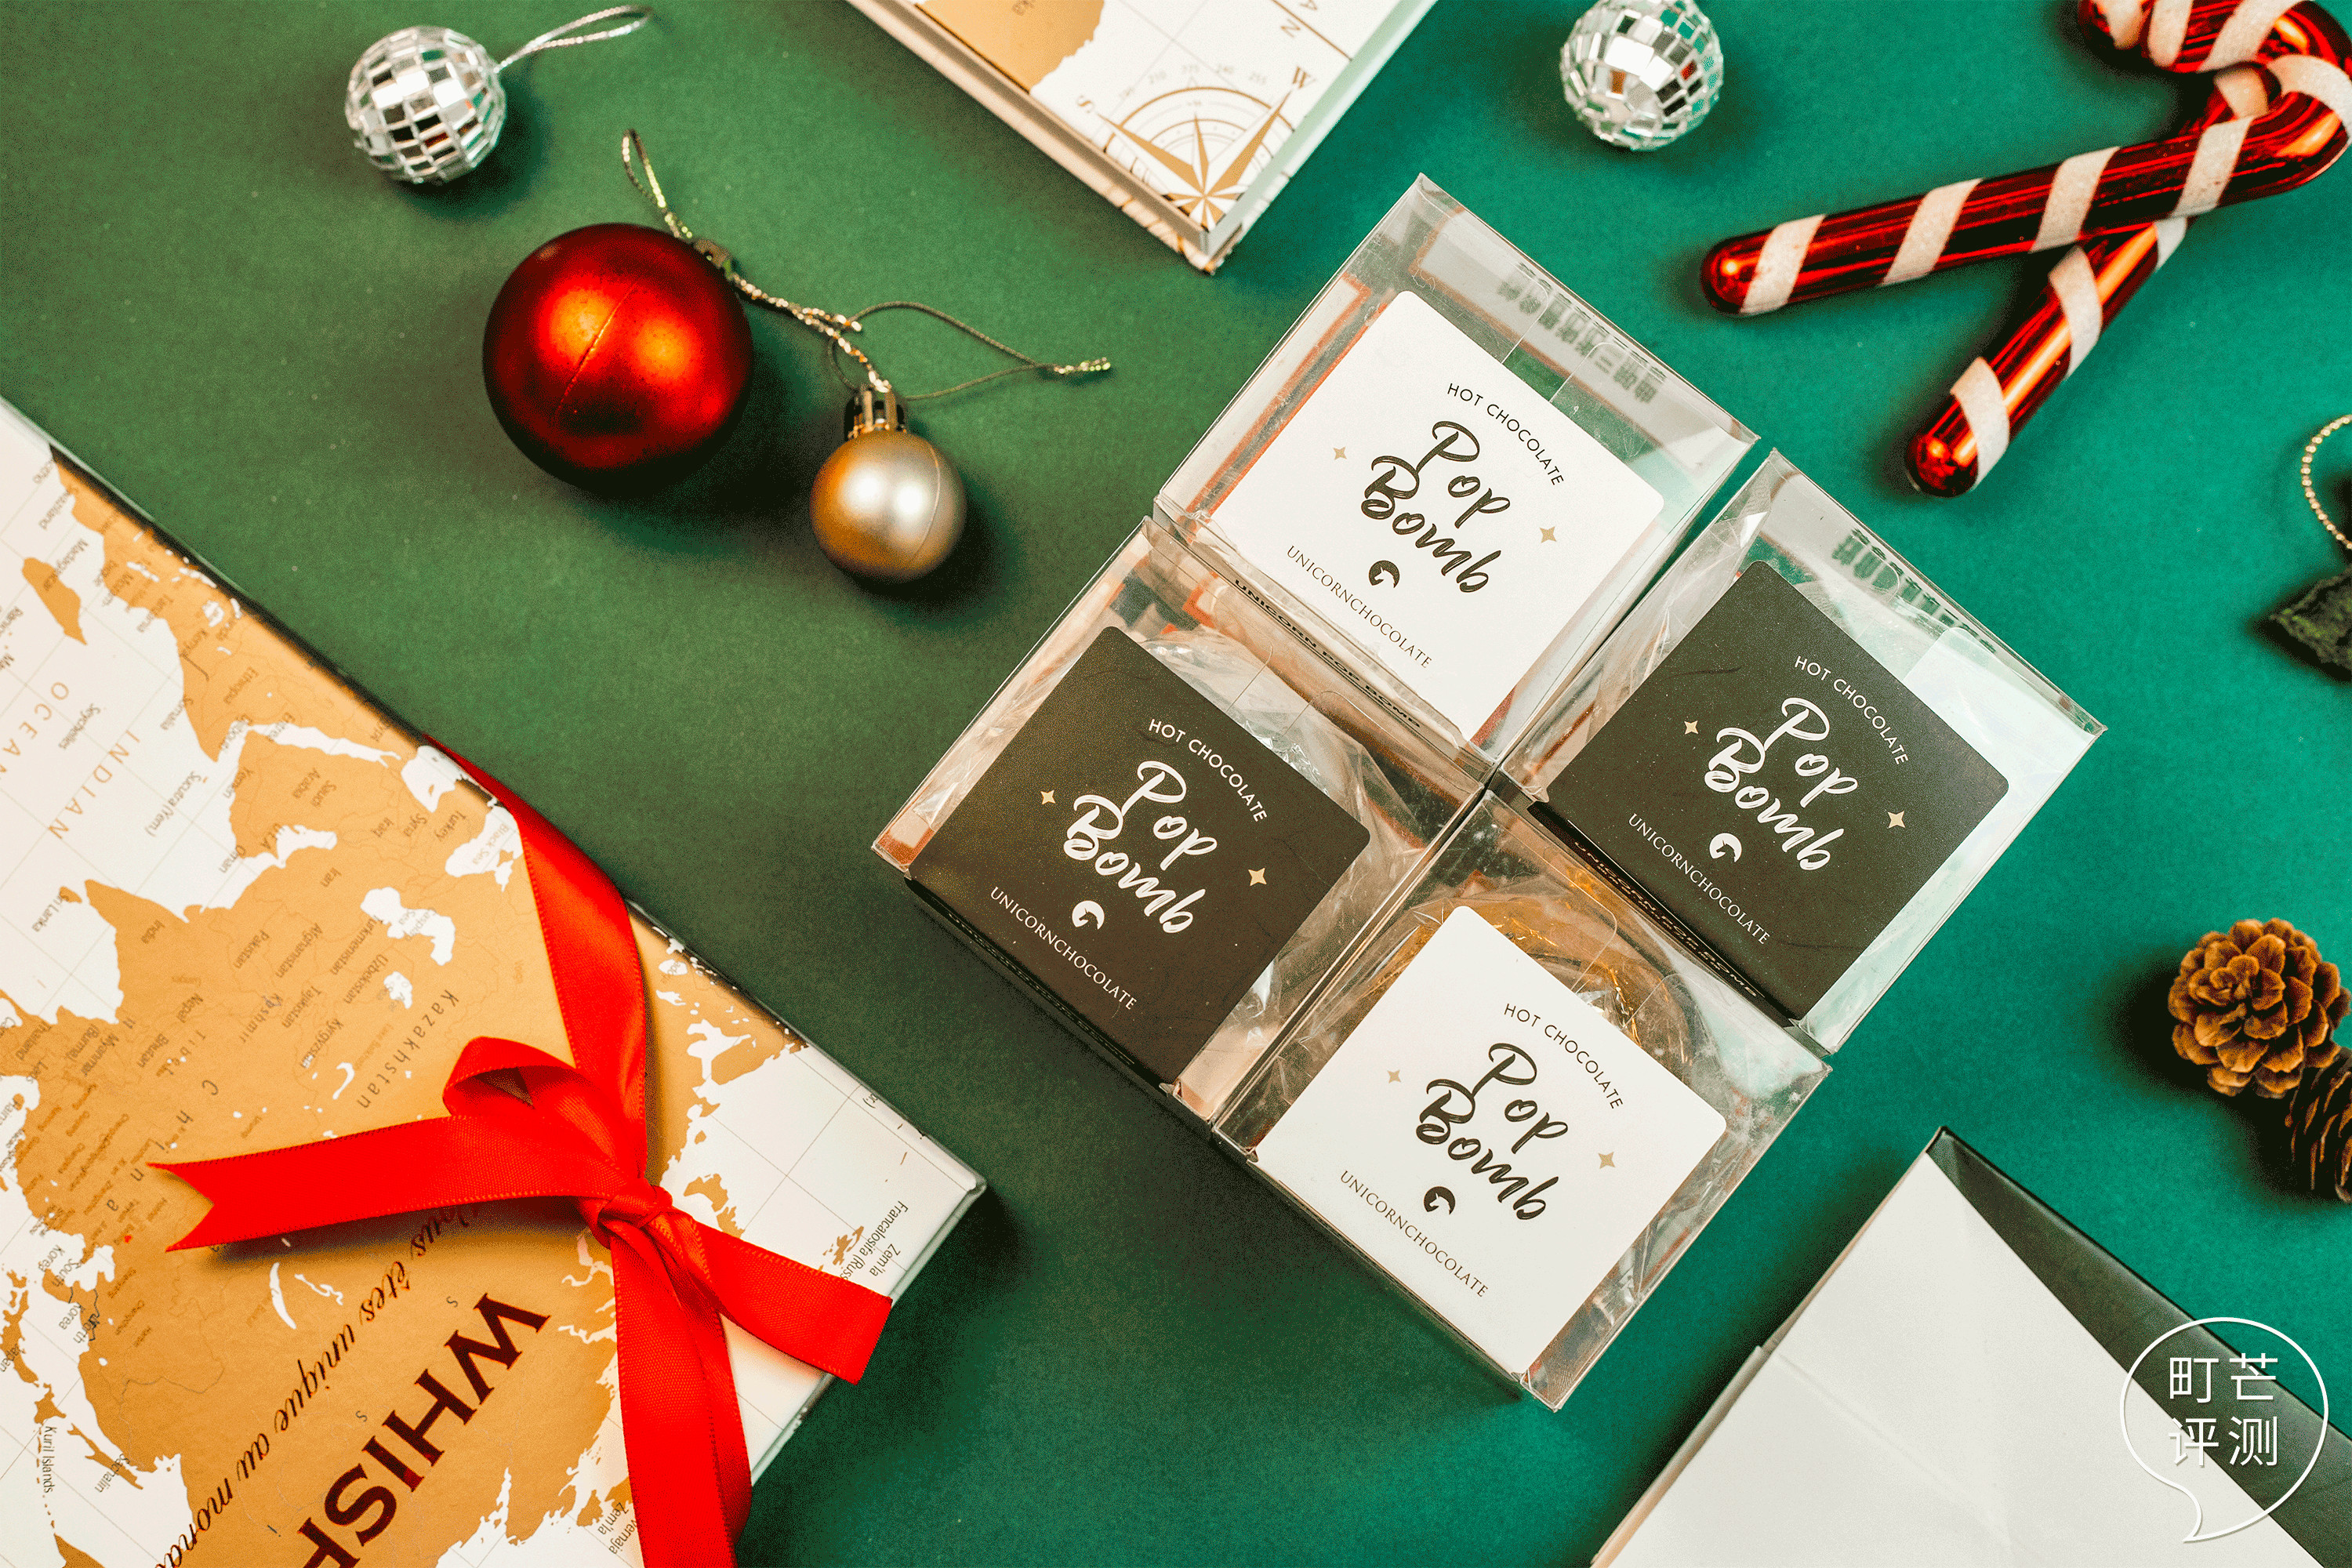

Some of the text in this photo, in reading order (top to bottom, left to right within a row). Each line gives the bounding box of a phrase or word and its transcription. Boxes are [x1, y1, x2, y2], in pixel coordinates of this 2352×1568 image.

[1447, 383, 1564, 485] HOT CHOCOLATE
[1416, 421, 1510, 528] Pop
[38, 483, 78, 532] Swaziland
[1361, 456, 1501, 593] Bomb
[39, 536, 87, 593] Madagascar
[136, 593, 173, 637] Tanzania
[1287, 546, 1432, 666] UNICORNCHOCOLATE
[1230, 577, 1422, 730] UNICORN POP BOMB
[221, 665, 258, 707] Ethiopia
[1795, 656, 1908, 764] HOT CHOCOLATE
[57, 701, 100, 753] Seychelles
[160, 694, 194, 732] Somalia
[1149, 719, 1267, 822] HOT CHOCOLATE
[1762, 698, 1857, 808] Pop
[48, 728, 140, 840] INDIAN
[168, 770, 201, 808] Sucutra
[222, 764, 253, 800] Yemen
[291, 767, 321, 800] Arabia
[310, 780, 336, 810] Saudi
[1704, 728, 1844, 870] Bomb
[371, 815, 393, 839] Iraq
[401, 811, 426, 839] Syria
[433, 808, 465, 844] Turkey
[1118, 760, 1217, 870] Pop
[218, 844, 246, 875] Oman
[471, 823, 509, 866] Black Sea
[1064, 795, 1205, 933] Bomb
[320, 867, 340, 889] Iran
[1629, 814, 1769, 944] UNICORNCHOCOLATE
[30, 891, 69, 935] Sri Lanka
[140, 919, 164, 946] India
[397, 907, 415, 927] Sea
[1570, 840, 1659, 913] UNICORN
[1658, 913, 1700, 949] POP
[1700, 949, 1759, 998] BOMB
[233, 928, 269, 971] Pakistan
[273, 920, 323, 981] Afghanistan
[329, 913, 383, 978] Turkmenistan
[991, 887, 1136, 1010] UNICORNCHOCOLATE
[343, 953, 387, 1007] Uzbekistan
[174, 991, 202, 1023] Nepal
[280, 983, 320, 1030] Tajikistan
[15, 1019, 51, 1062] Thailand
[64, 1023, 100, 1064] (Burma)
[78, 1030, 118, 1079] Myanmar
[136, 1033, 169, 1070] Bhutan
[296, 1016, 343, 1070] Kyrgyzstan
[357, 988, 458, 1113] Kazakhstan
[1504, 1004, 1623, 1109] HOT CHOCOLATE
[25, 1062, 47, 1086] Laos
[1469, 1043, 1568, 1154] Pop
[105, 1076, 220, 1217] China
[1416, 1079, 1559, 1220] Bomb
[858, 1200, 907, 1258] Francalosifa
[1341, 1171, 1488, 1297] UNICORNCHOCOLATE
[36, 1243, 63, 1273] Korea
[50, 1257, 78, 1289] South
[869, 1243, 900, 1279] Zem'la
[56, 1301, 84, 1331] Korea
[360, 1261, 410, 1325] êtes
[0, 1341, 24, 1374] Japan
[274, 1323, 355, 1433] unique
[42, 1426, 57, 1494] Kuril Islands
[93, 1452, 131, 1495] Sachalin
[237, 1433, 270, 1481] au
[597, 1502, 628, 1537] Zem'la
